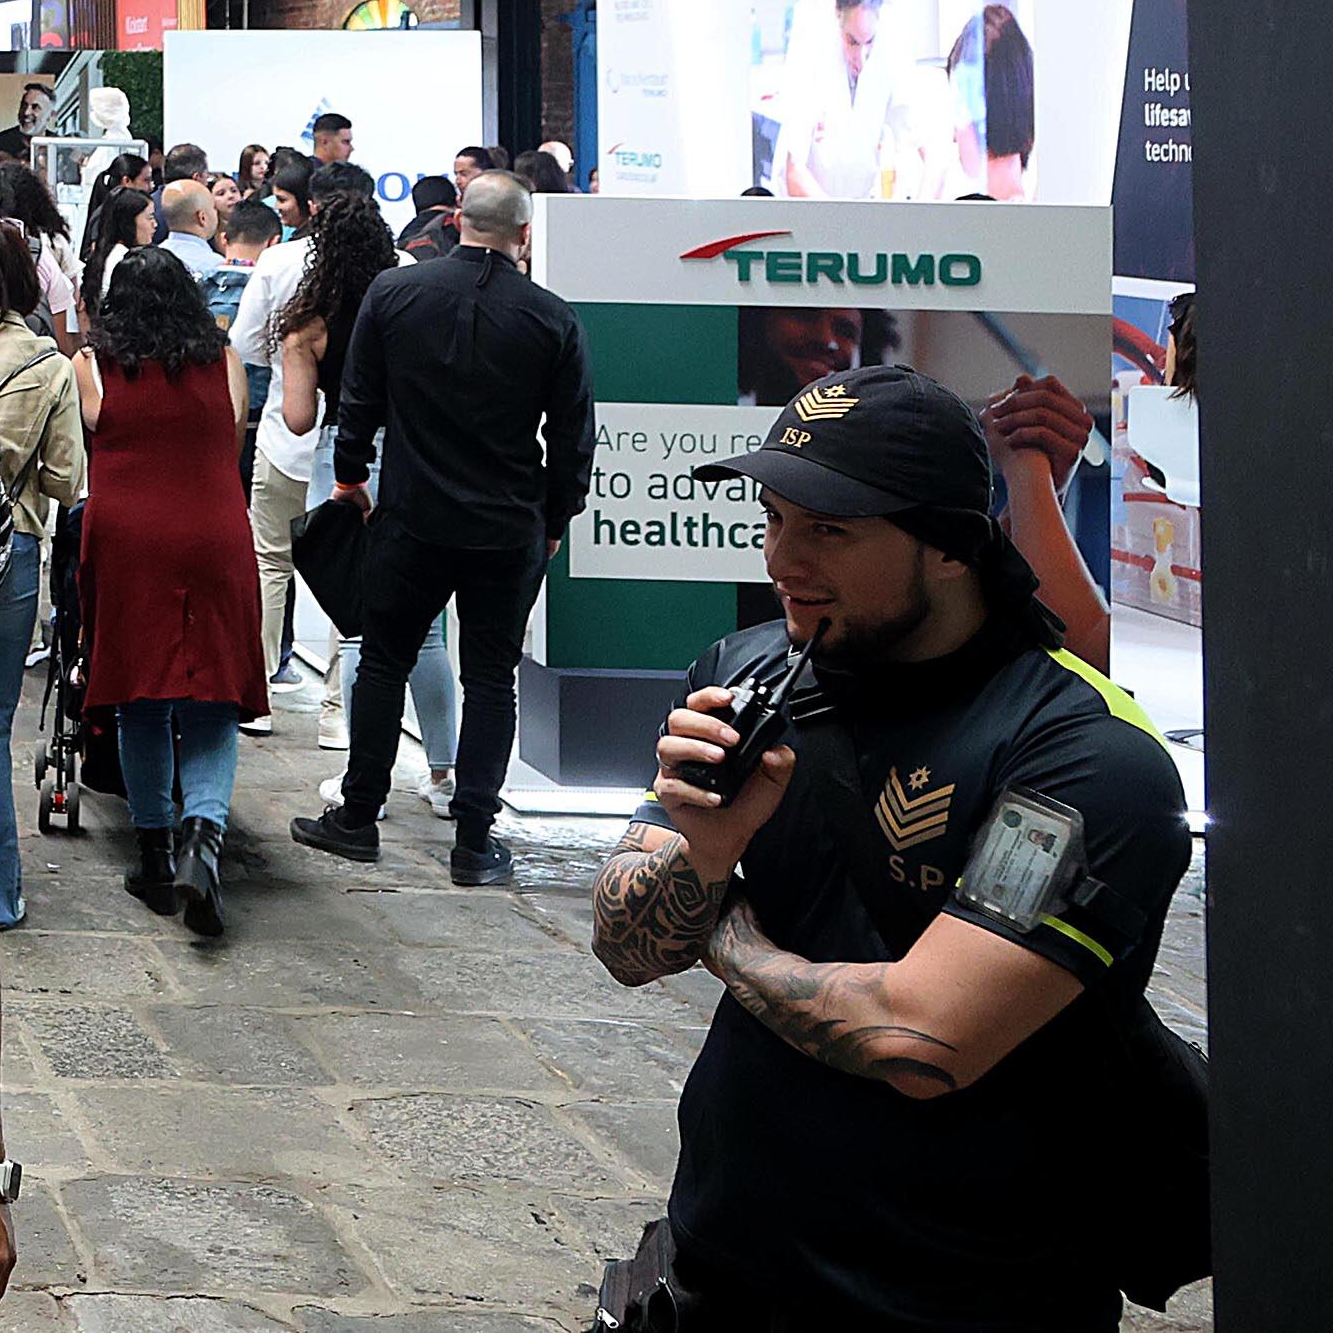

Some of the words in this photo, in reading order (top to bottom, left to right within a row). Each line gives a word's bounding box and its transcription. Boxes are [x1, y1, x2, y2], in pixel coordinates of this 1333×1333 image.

[1144, 68, 1181, 97] Help
[724, 250, 982, 287] TERUMO
[594, 424, 648, 452] Are
[660, 431, 717, 460] you
[779, 427, 812, 448] ISP
[593, 466, 632, 499] to
[593, 510, 767, 550] healthca
